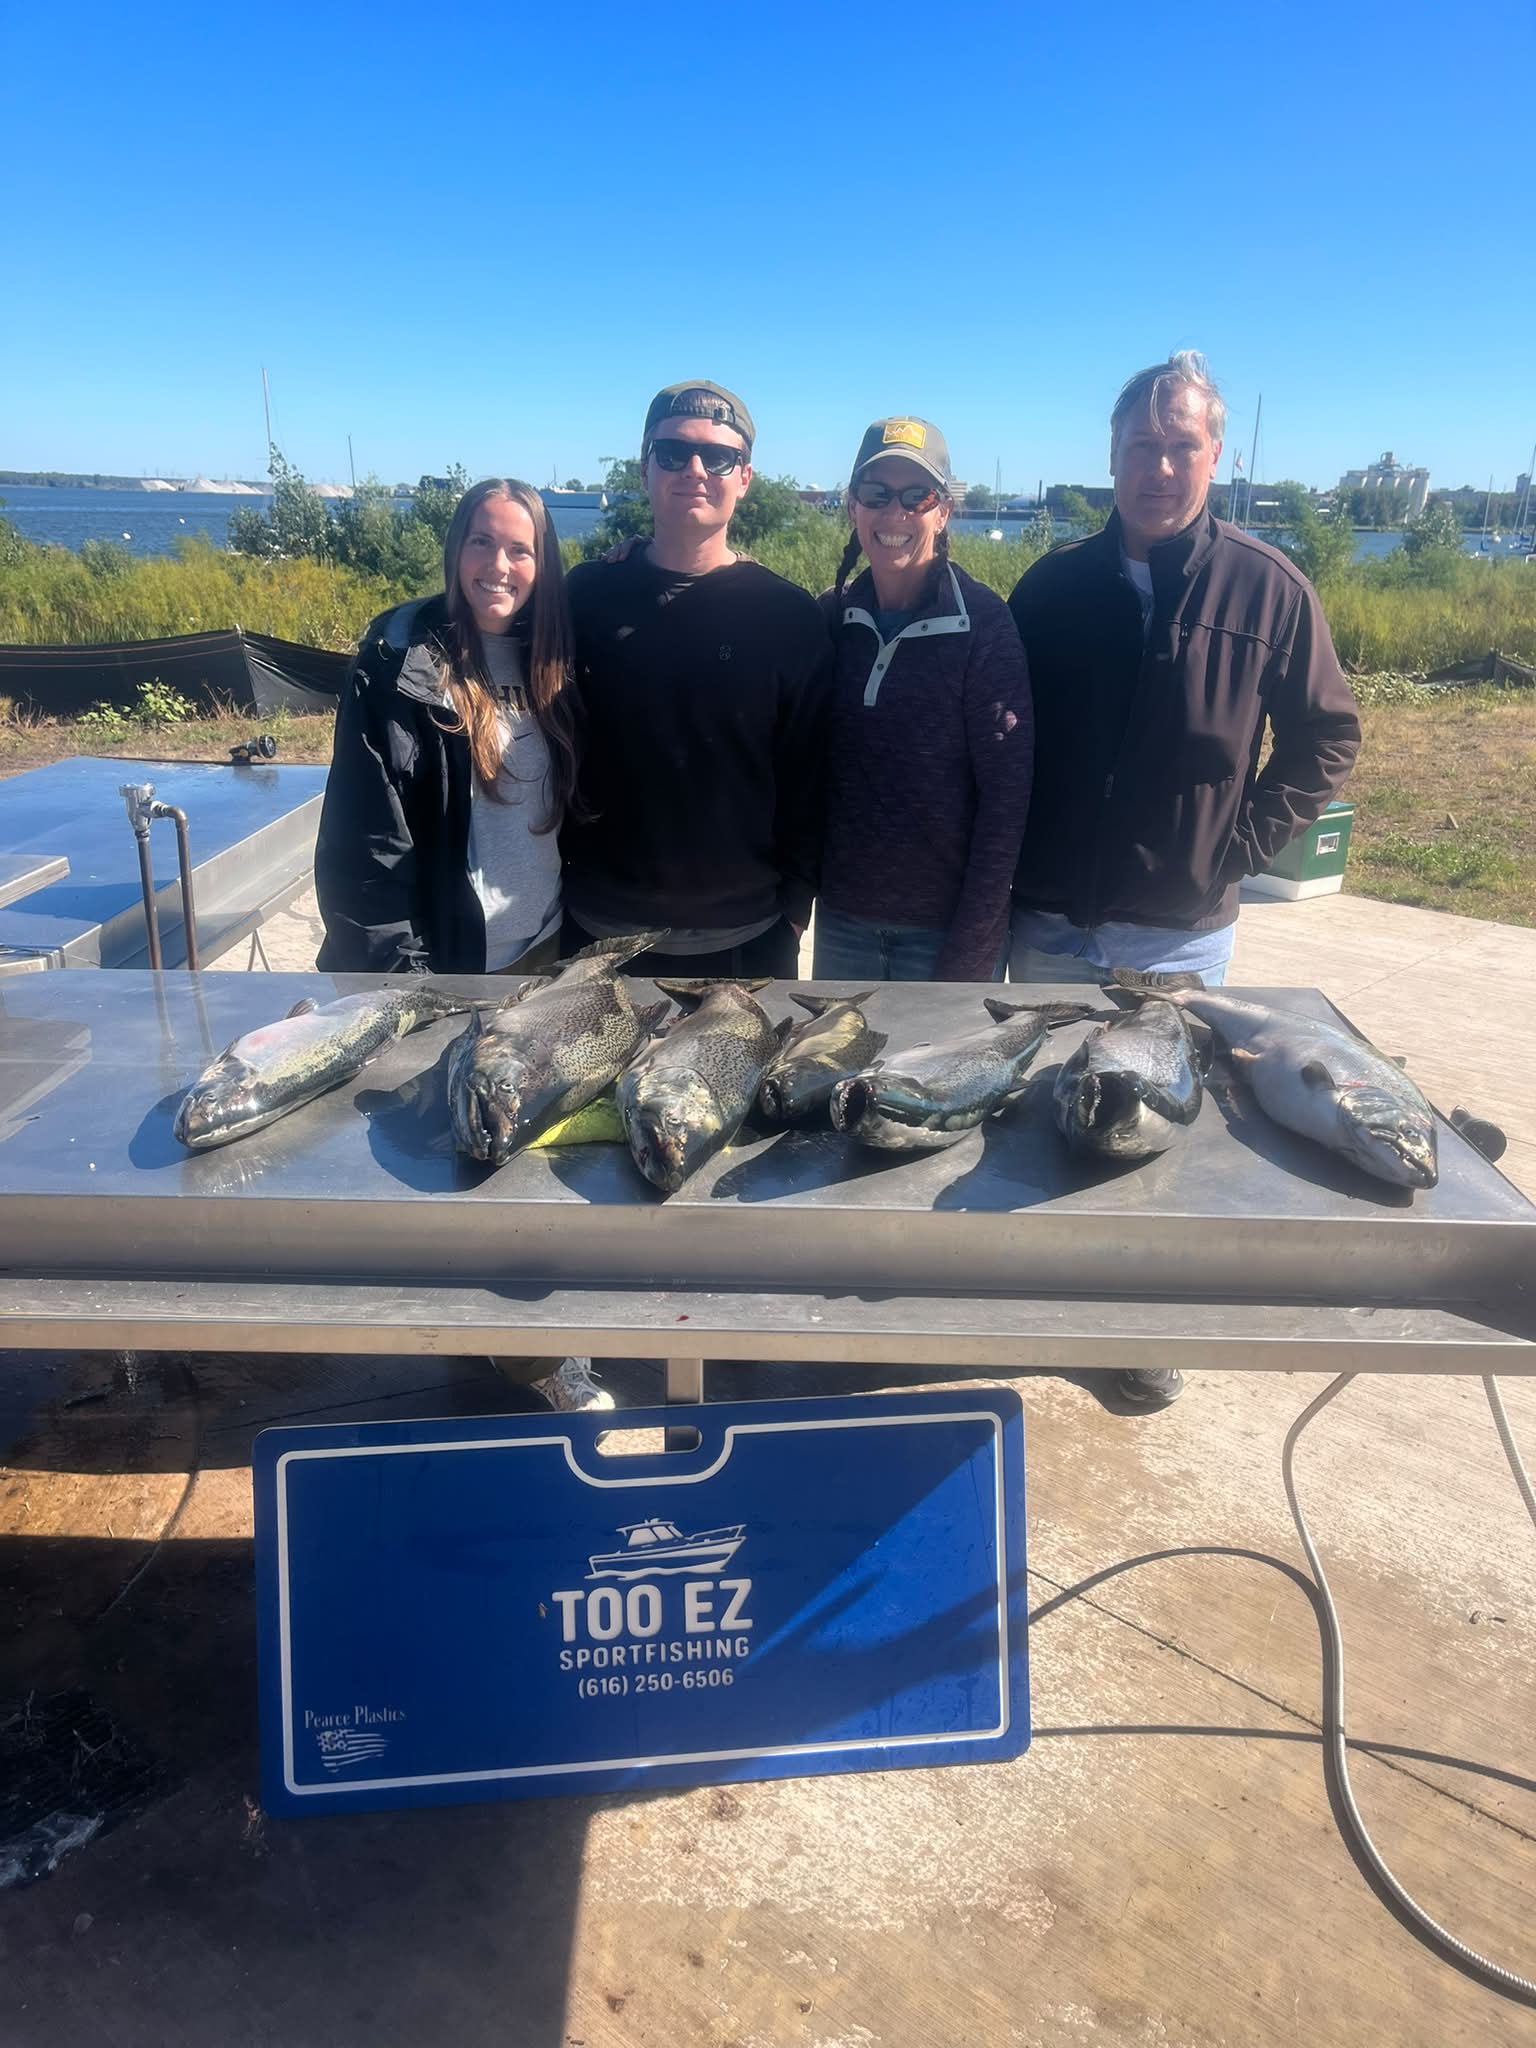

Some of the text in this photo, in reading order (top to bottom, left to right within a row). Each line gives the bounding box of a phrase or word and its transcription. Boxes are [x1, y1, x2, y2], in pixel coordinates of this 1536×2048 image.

[551, 1578, 753, 1642] TOO EZ
[559, 1637, 749, 1670] SPORTFISHING
[578, 1668, 734, 1699] (616) 250-6506
[304, 1705, 406, 1729] Pearce Plastics
